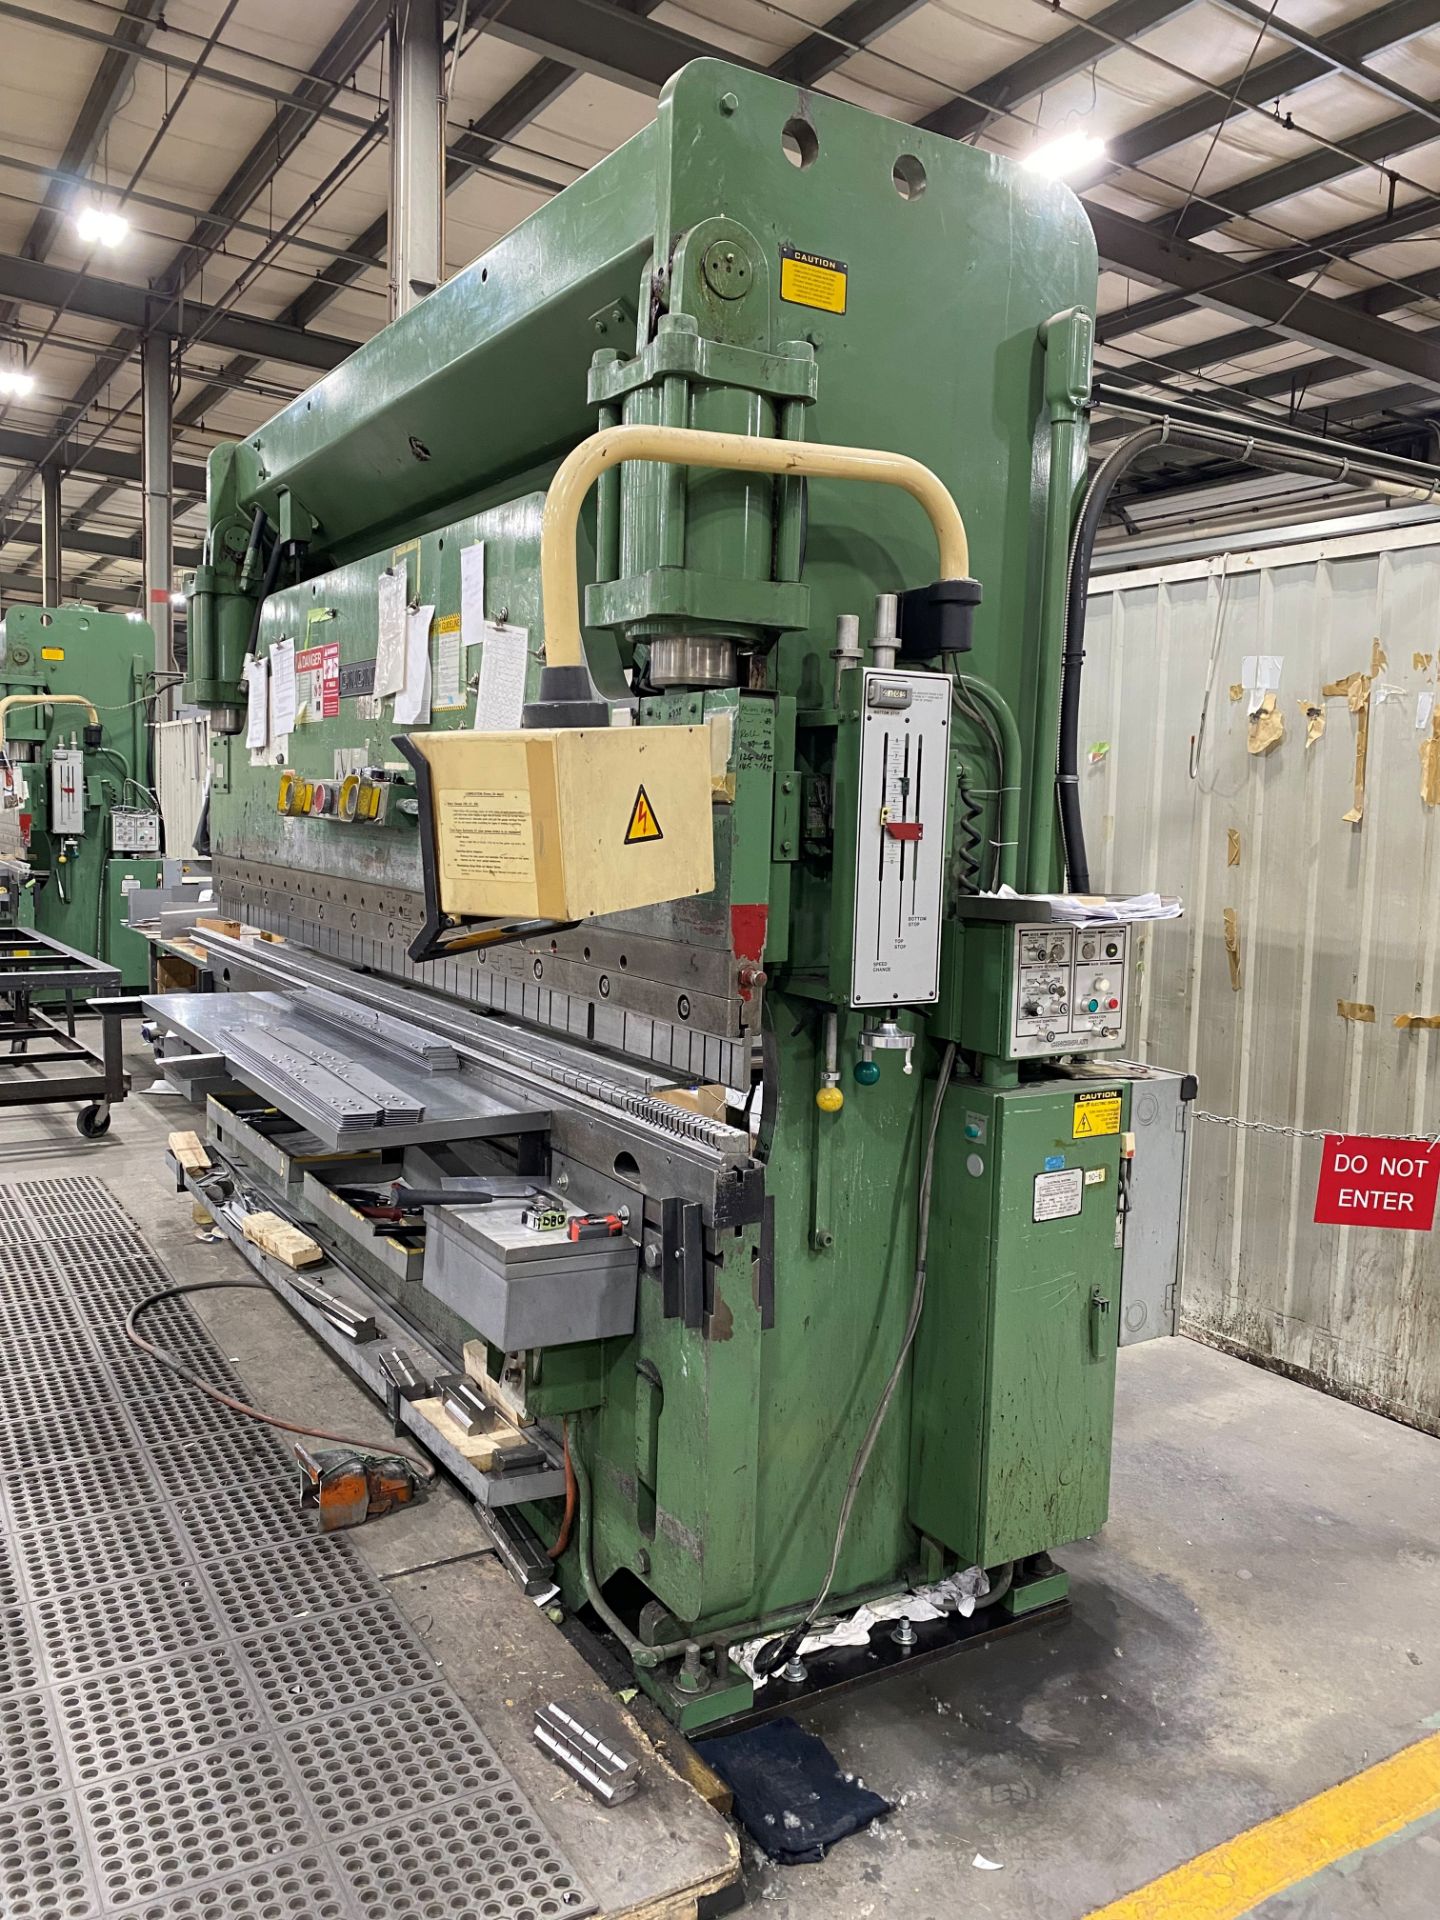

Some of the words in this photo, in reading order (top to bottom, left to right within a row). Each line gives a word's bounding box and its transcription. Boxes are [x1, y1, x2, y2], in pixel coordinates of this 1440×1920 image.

[794, 251, 836, 269] CAUTION
[302, 652, 322, 668] DANGER
[1079, 1091, 1117, 1101] CAUTION
[1334, 1154, 1368, 1174] DO
[1380, 1157, 1429, 1178] NOT
[1338, 1188, 1414, 1211] ENTER
